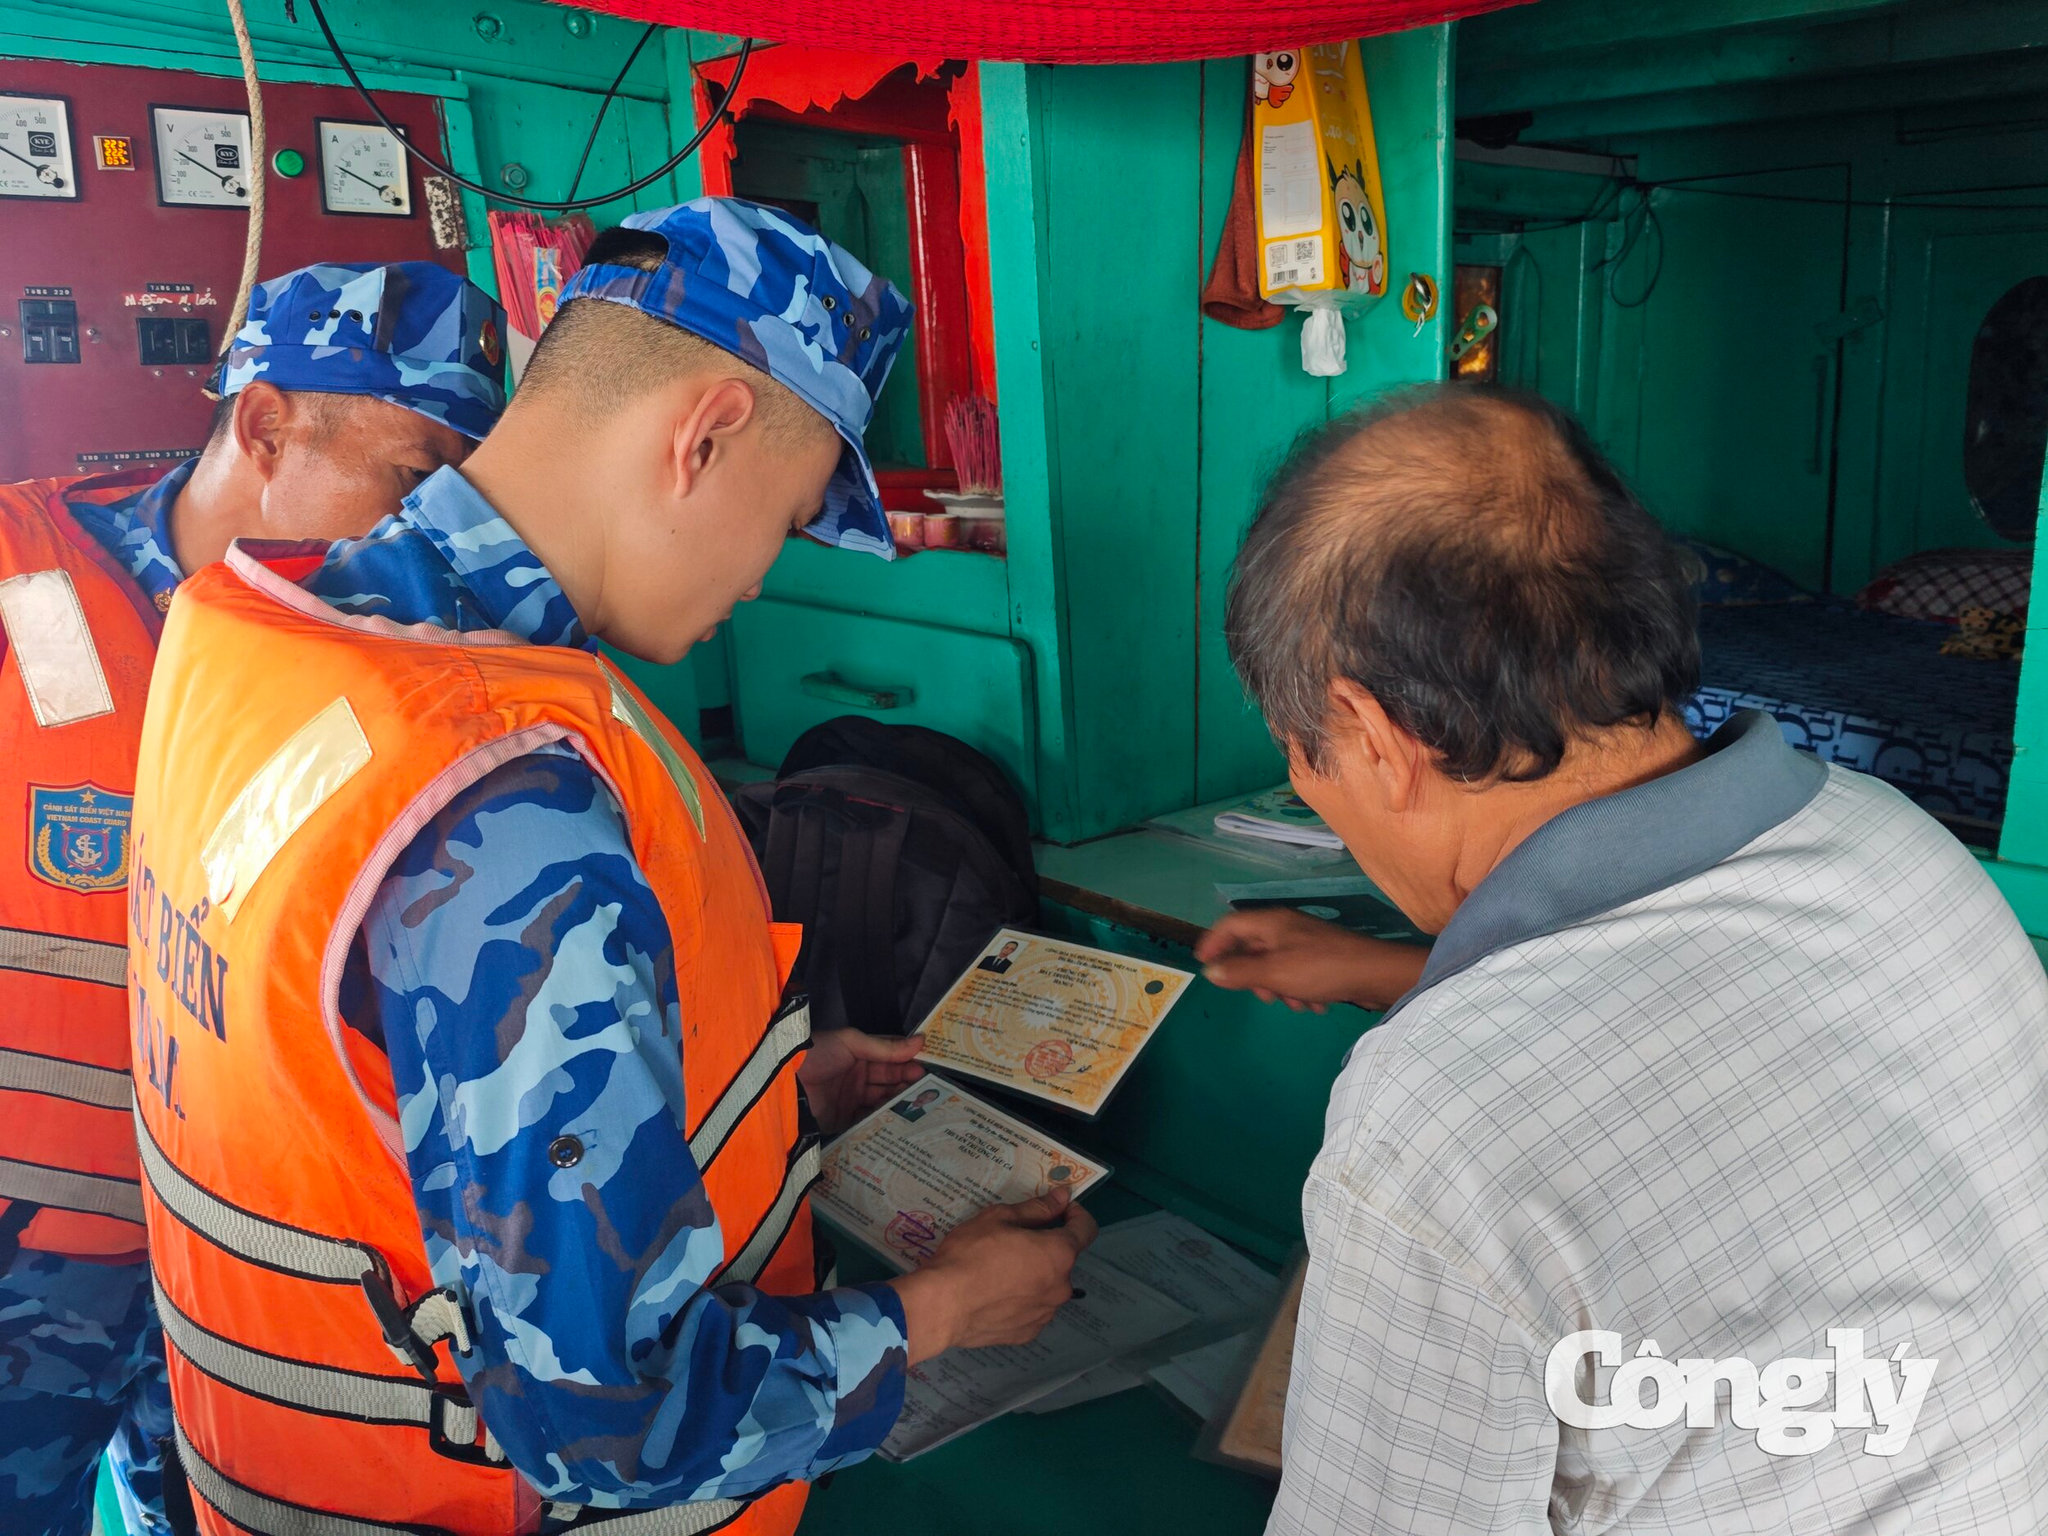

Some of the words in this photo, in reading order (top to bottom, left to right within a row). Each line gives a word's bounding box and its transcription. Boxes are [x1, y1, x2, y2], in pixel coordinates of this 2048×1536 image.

[166, 124, 174, 133] V
[331, 134, 338, 143] A
[43, 802, 62, 812] CẢNH
[64, 804, 78, 812] SÁT
[80, 804, 97, 814] BIỂN
[98, 807, 114, 816] VIỆT
[46, 814, 78, 822] VIETNAM
[80, 816, 102, 824] COAST
[104, 818, 126, 826] GUARD
[157, 892, 228, 1044] BIỂN
